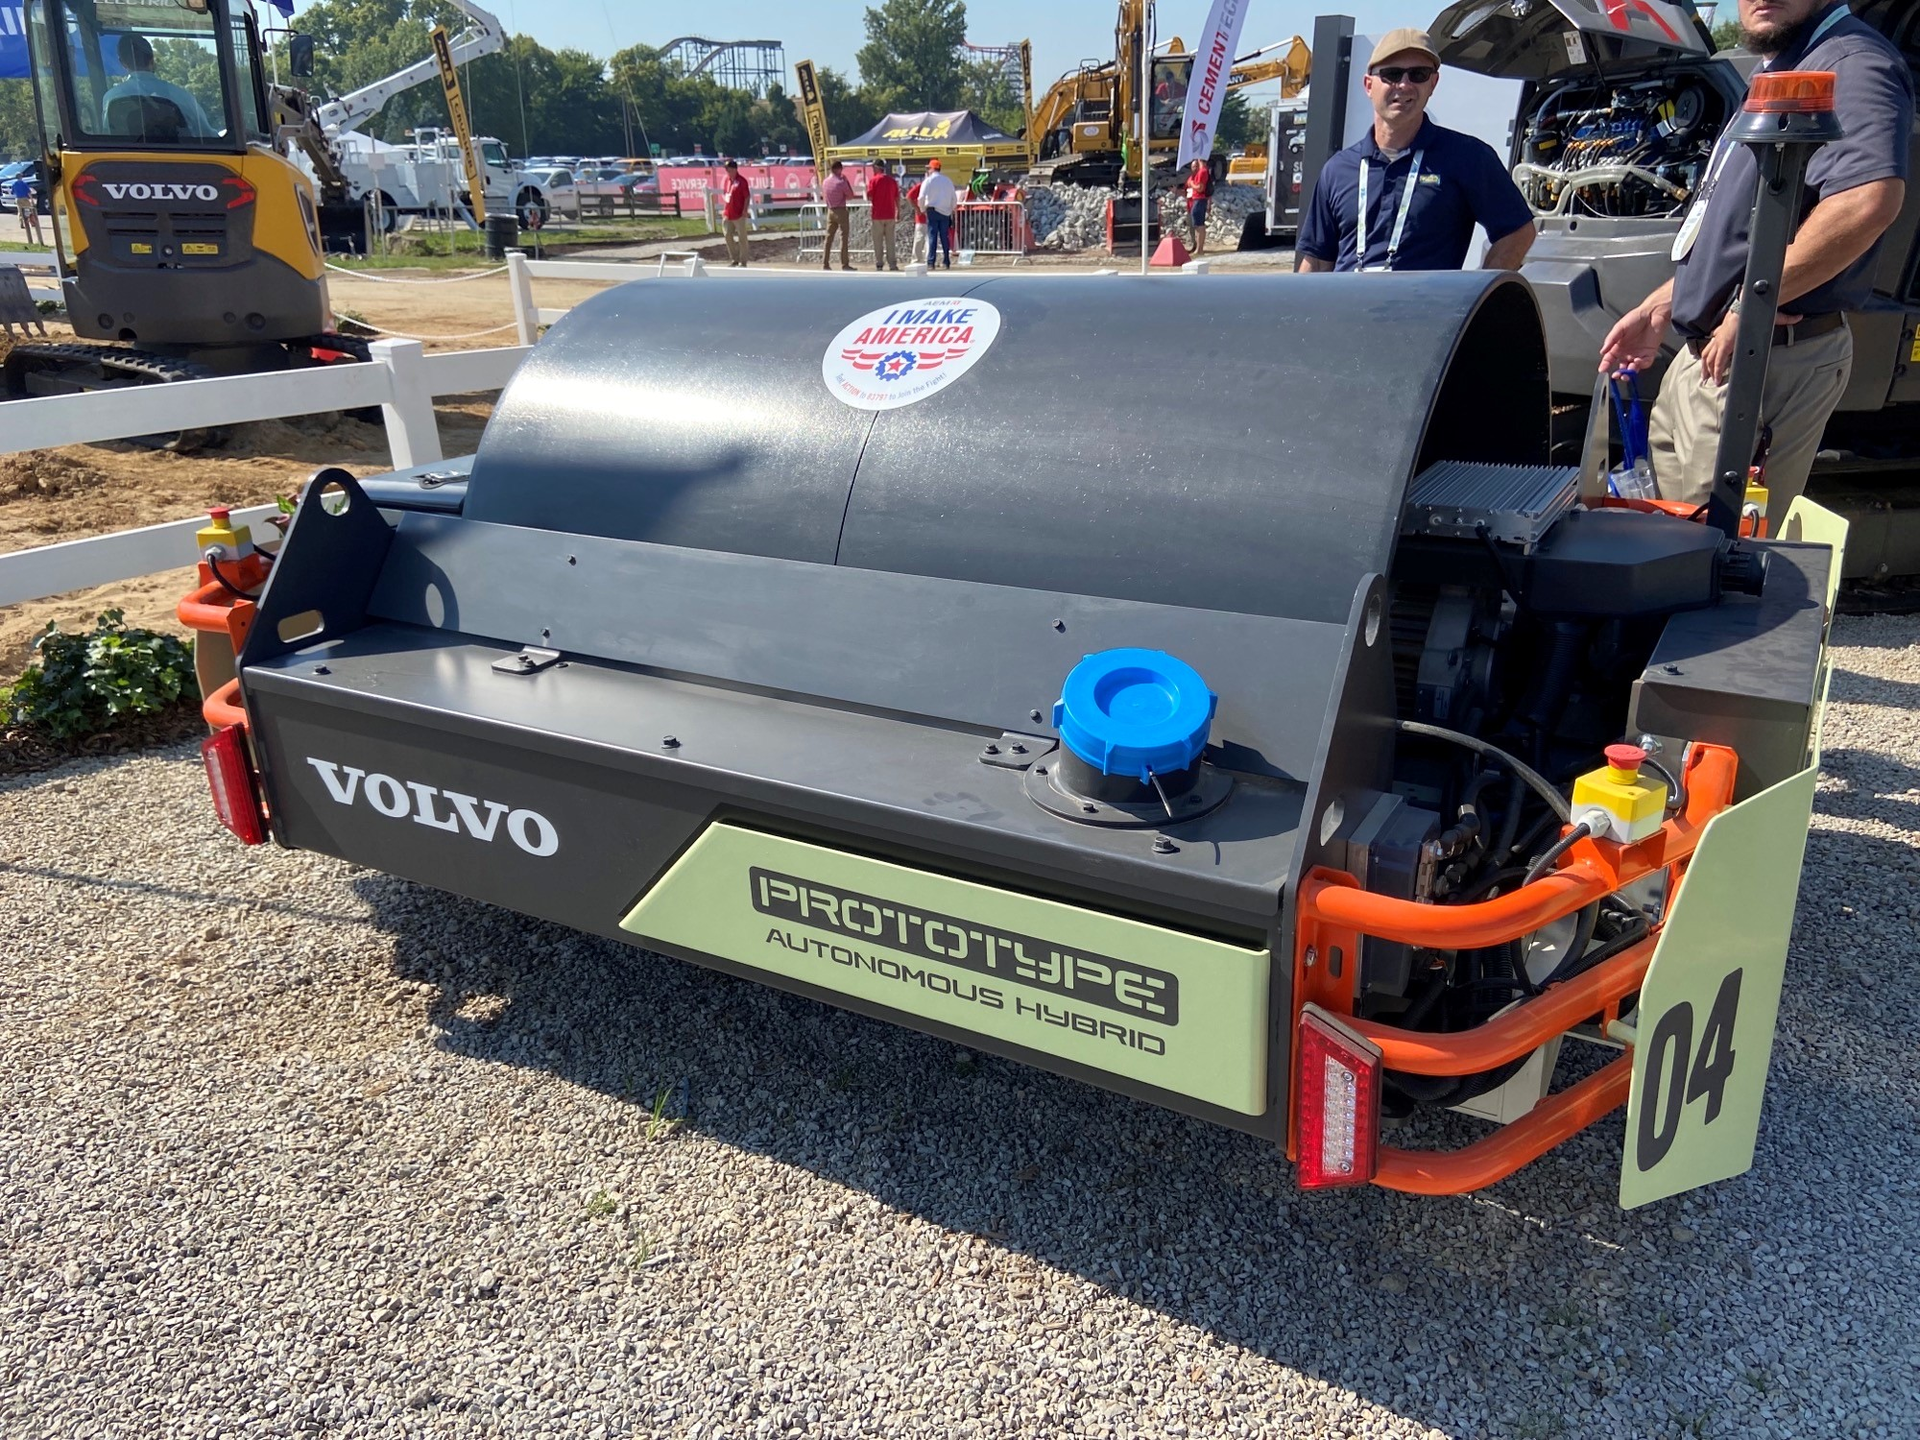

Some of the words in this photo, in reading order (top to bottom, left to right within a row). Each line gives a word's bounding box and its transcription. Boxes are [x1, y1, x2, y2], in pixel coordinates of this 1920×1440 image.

[102, 183, 218, 201] VOLVO
[852, 326, 975, 345] AMERICA
[883, 309, 900, 325] I
[896, 308, 979, 325] MAKE
[912, 385, 925, 395] the
[307, 757, 559, 857] VOLVO
[758, 875, 1167, 1017] PROTOTYPE
[765, 928, 1003, 1010] AUTONOMOUS
[1016, 997, 1166, 1056] HYBRID
[1637, 967, 1743, 1172] 04
